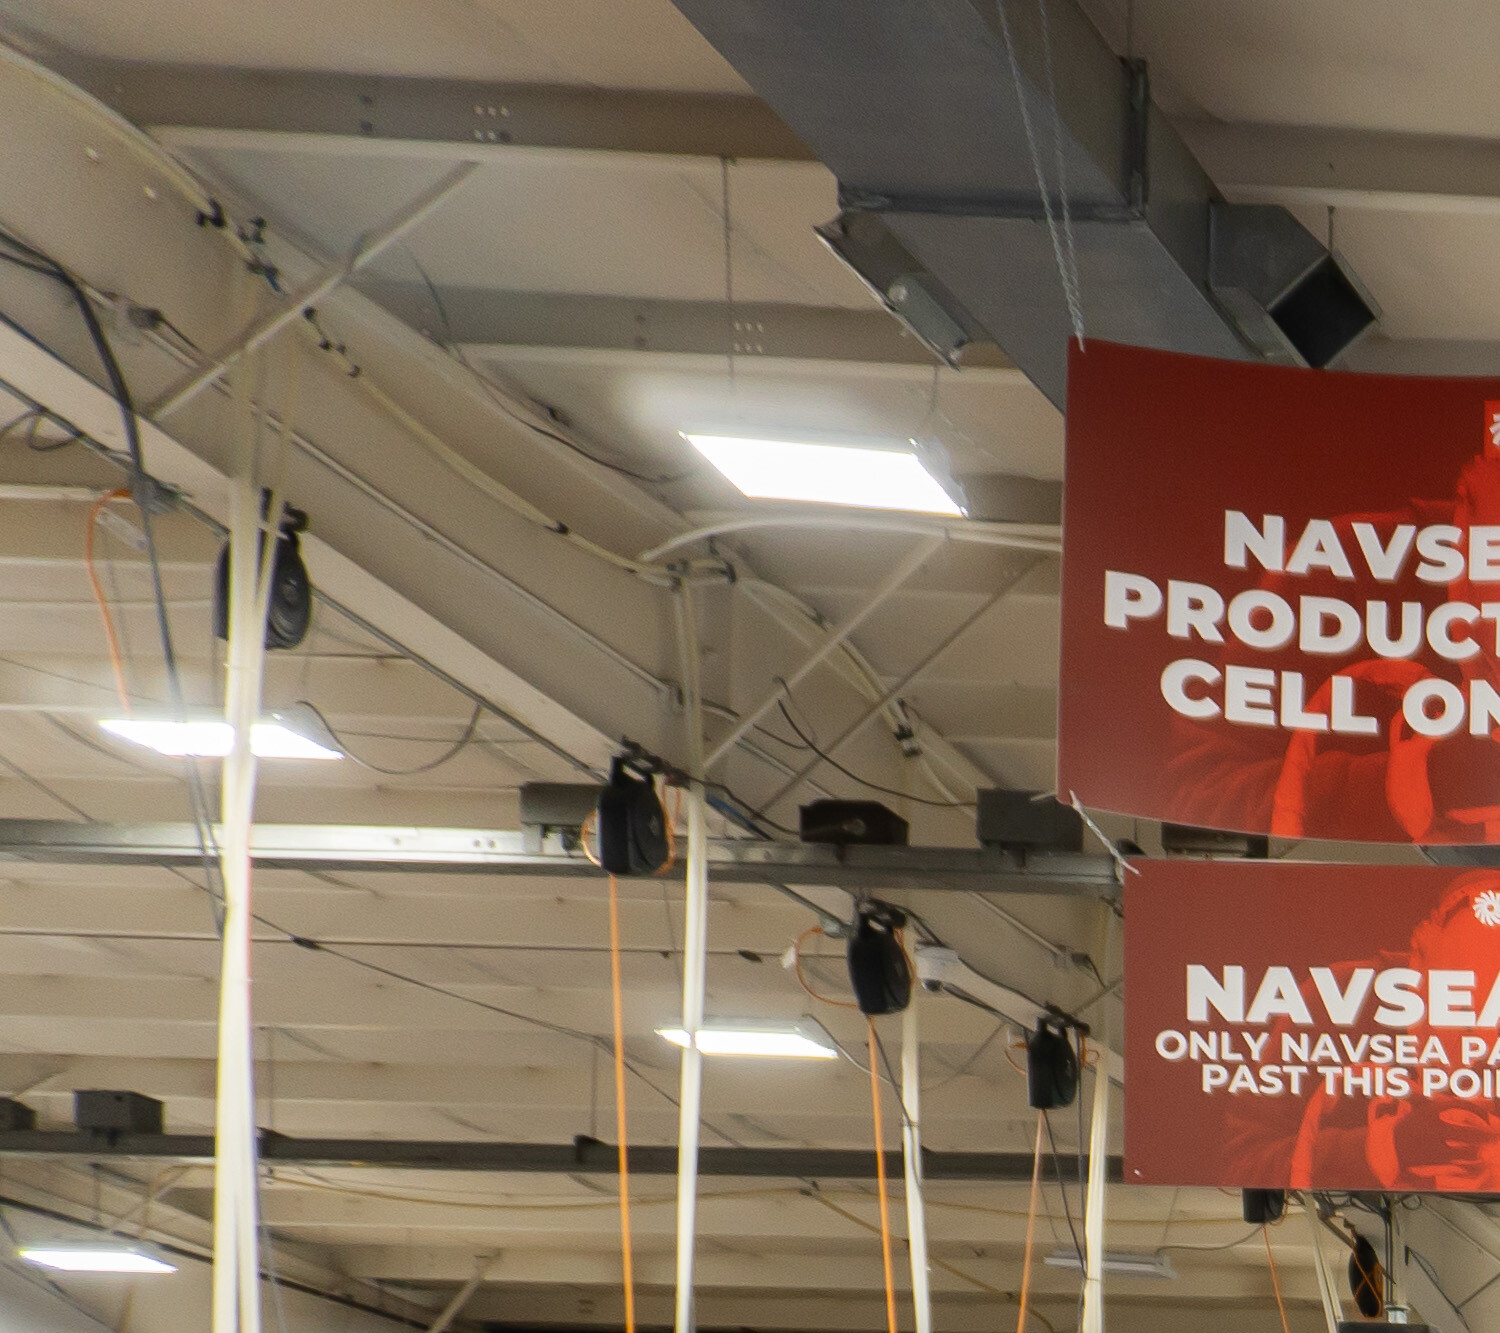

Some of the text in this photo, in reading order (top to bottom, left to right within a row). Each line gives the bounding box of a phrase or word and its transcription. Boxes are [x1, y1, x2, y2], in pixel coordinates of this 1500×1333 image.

[1160, 657, 1379, 735] CELL
[1155, 1029, 1270, 1063] ONLY
[1281, 1032, 1451, 1066] NAVSEA
[1203, 1064, 1308, 1096] PAST
[1317, 1066, 1411, 1098] THIS
